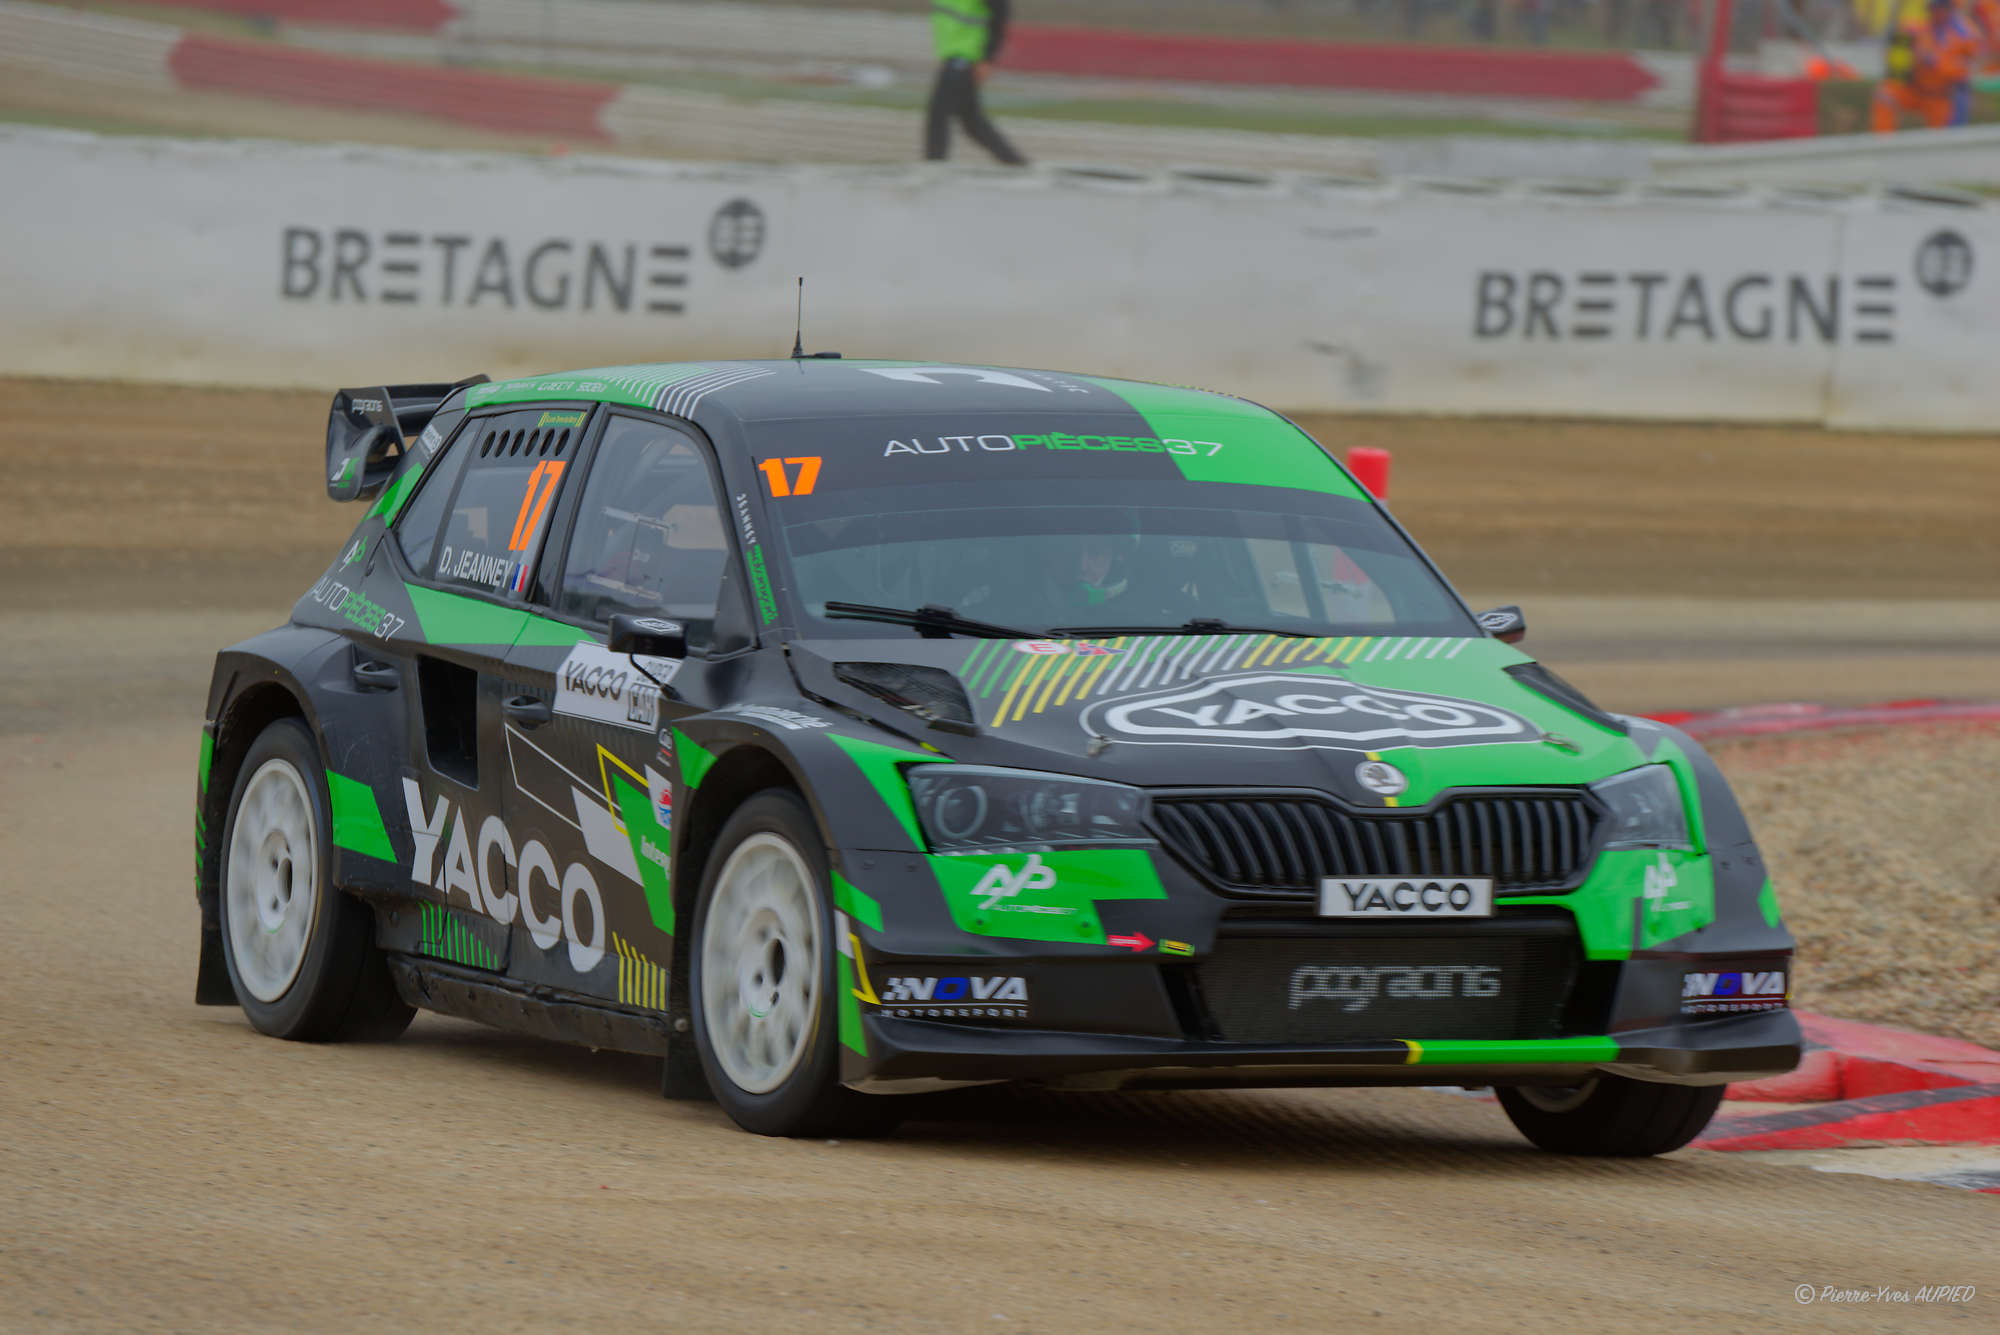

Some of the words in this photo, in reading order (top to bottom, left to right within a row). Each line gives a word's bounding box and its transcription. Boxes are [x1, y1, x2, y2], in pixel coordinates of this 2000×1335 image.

[282, 226, 690, 316] BRETAGNE
[1474, 271, 1896, 343] BRETAGNE
[884, 432, 1223, 457] AUTOPIÈCES37
[759, 456, 822, 498] 17
[509, 460, 567, 551] 17
[439, 546, 453, 575] D.
[453, 549, 514, 589] JEANNEY
[566, 660, 628, 701] YACCO
[1153, 694, 1476, 726] YACCO
[402, 776, 606, 973] YACCO
[1341, 882, 1472, 912] YACCO
[900, 977, 1029, 1000] NOVA
[1690, 971, 1785, 995] NOVA
